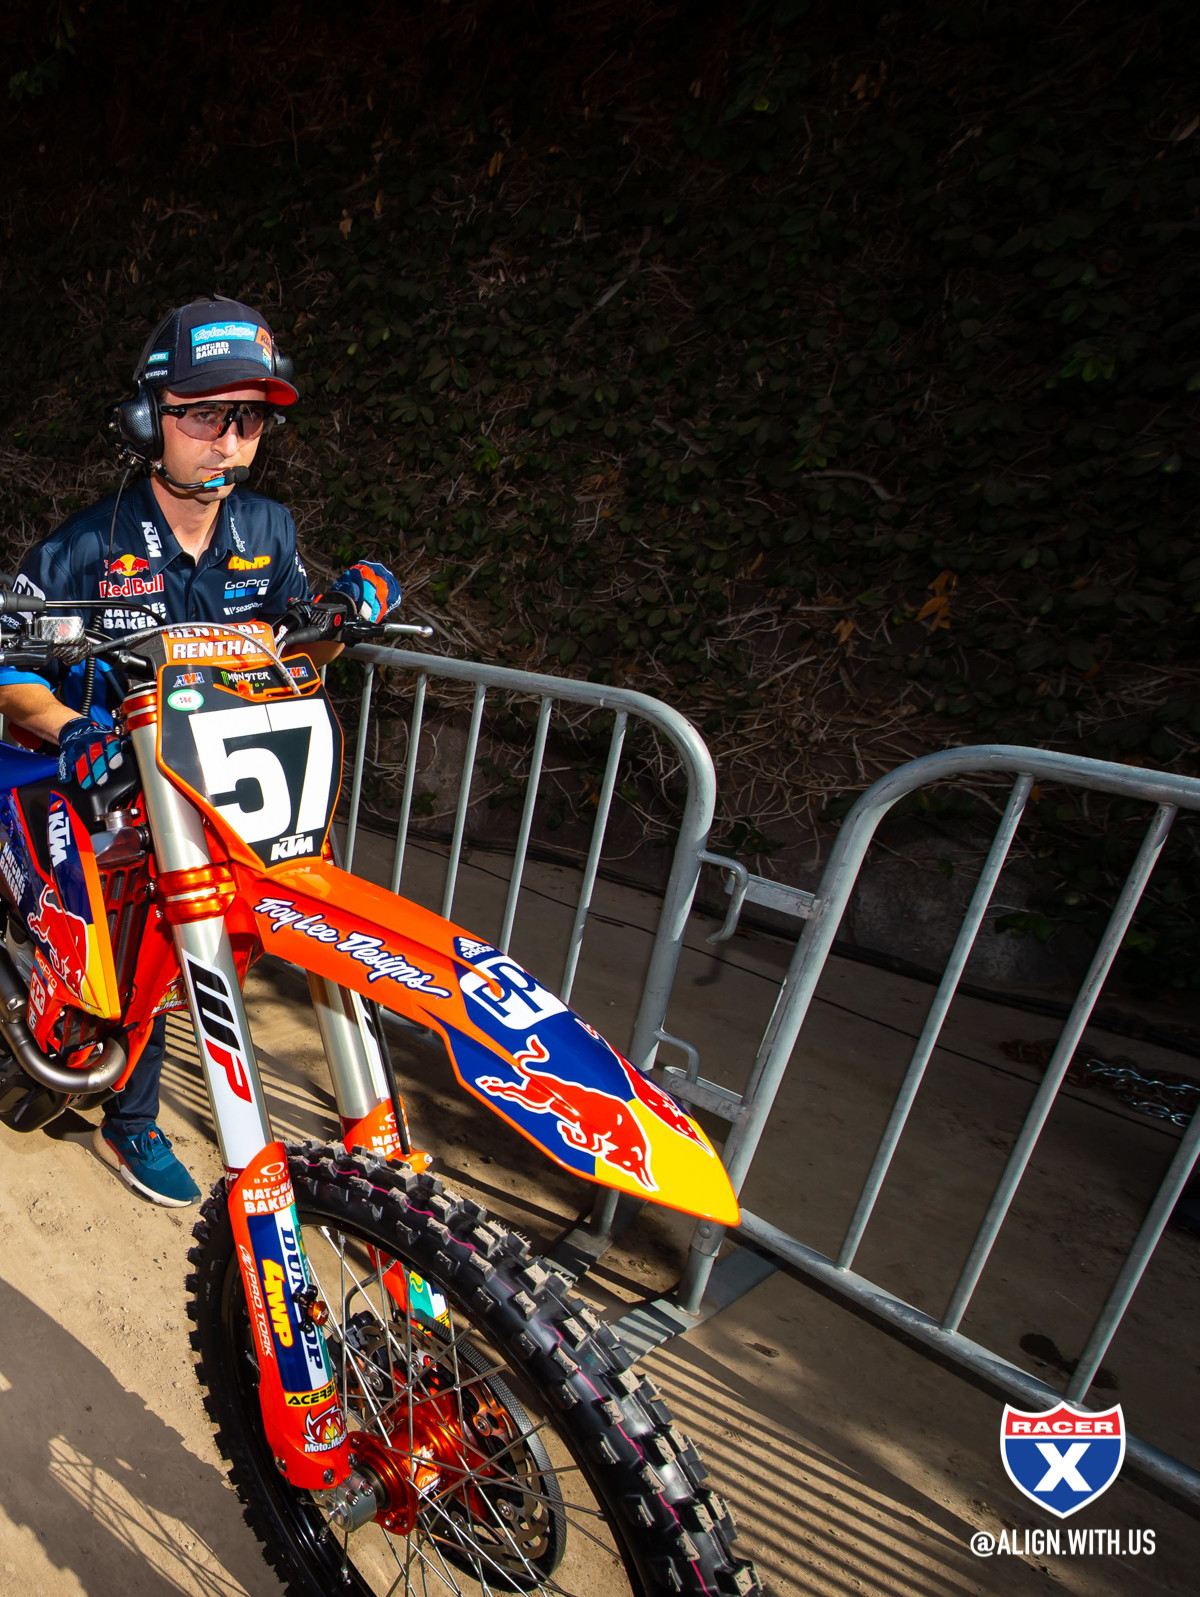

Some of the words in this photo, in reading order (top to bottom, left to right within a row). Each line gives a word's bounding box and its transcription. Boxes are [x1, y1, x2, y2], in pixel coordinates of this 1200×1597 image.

[141, 521, 163, 558] KTM
[228, 555, 271, 571] 4WP
[99, 577, 131, 599] Red
[131, 573, 165, 595] Bull
[224, 578, 270, 590] GoPro
[173, 671, 205, 688] AMA
[227, 671, 271, 682] MONSTER
[188, 699, 334, 844] 57
[48, 811, 71, 868] KTM
[270, 833, 314, 862] KTM
[254, 896, 302, 933] Troy
[295, 913, 339, 943] Lee
[335, 931, 452, 999] Designs
[463, 946, 495, 959] adidas
[248, 1272, 263, 1309] PRO
[257, 1311, 274, 1358] TORK
[261, 1258, 294, 1348] 4WP
